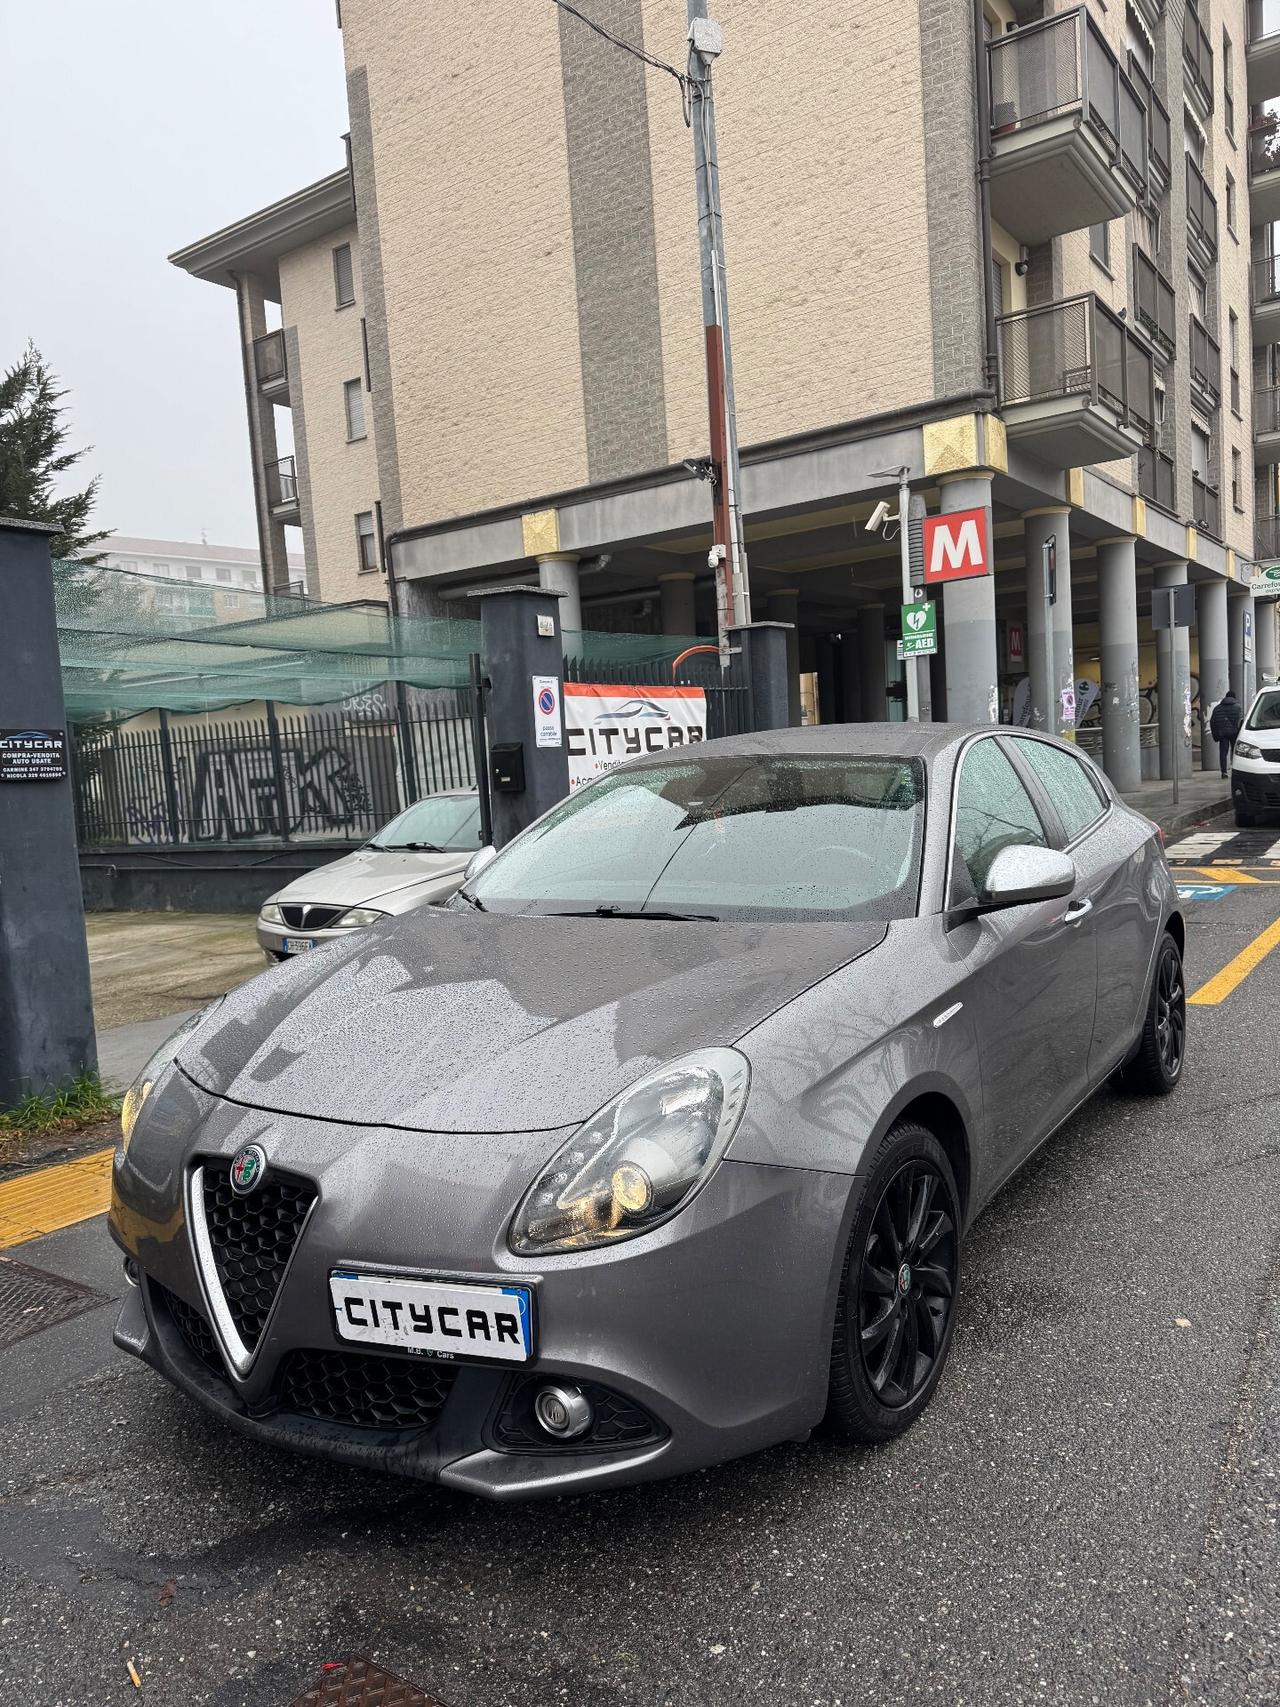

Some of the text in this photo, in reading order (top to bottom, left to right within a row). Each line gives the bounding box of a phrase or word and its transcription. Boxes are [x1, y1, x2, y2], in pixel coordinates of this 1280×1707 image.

[930, 520, 983, 573] M
[915, 638, 934, 649] AED
[1011, 631, 1021, 650] M
[566, 726, 703, 756] CITYCAR
[344, 1297, 521, 1344] CITYCAR
[436, 1350, 455, 1360] Cars
